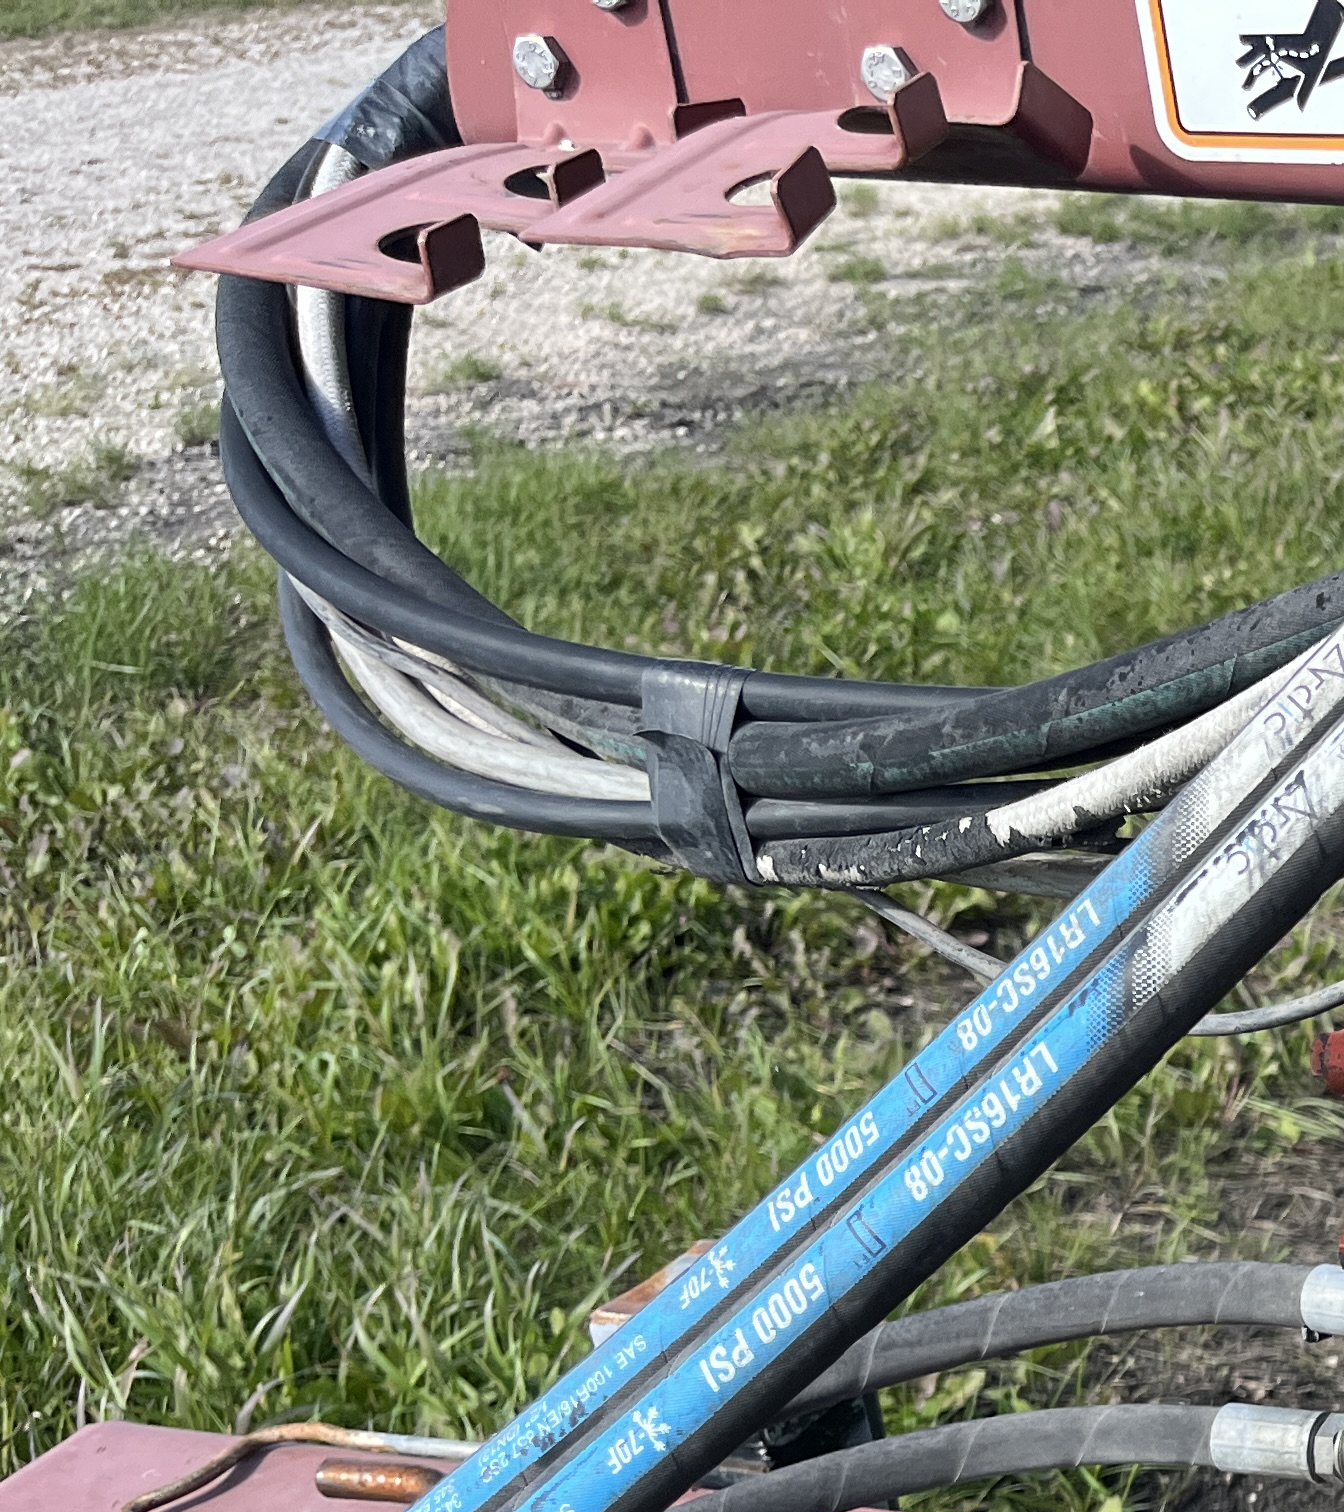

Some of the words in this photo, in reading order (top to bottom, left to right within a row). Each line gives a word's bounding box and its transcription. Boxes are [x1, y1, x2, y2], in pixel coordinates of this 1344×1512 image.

[1223, 770, 1323, 878] Arctic
[955, 897, 1101, 1051] LR16SC-08
[815, 1110, 880, 1187] 5000
[903, 1040, 1058, 1201] LR16SC-08
[766, 1172, 814, 1232] PSI
[752, 1263, 827, 1340] 5000
[612, 1333, 647, 1370] SAE
[699, 1329, 754, 1393] PSI
[535, 1364, 613, 1431] 100R16/EN
